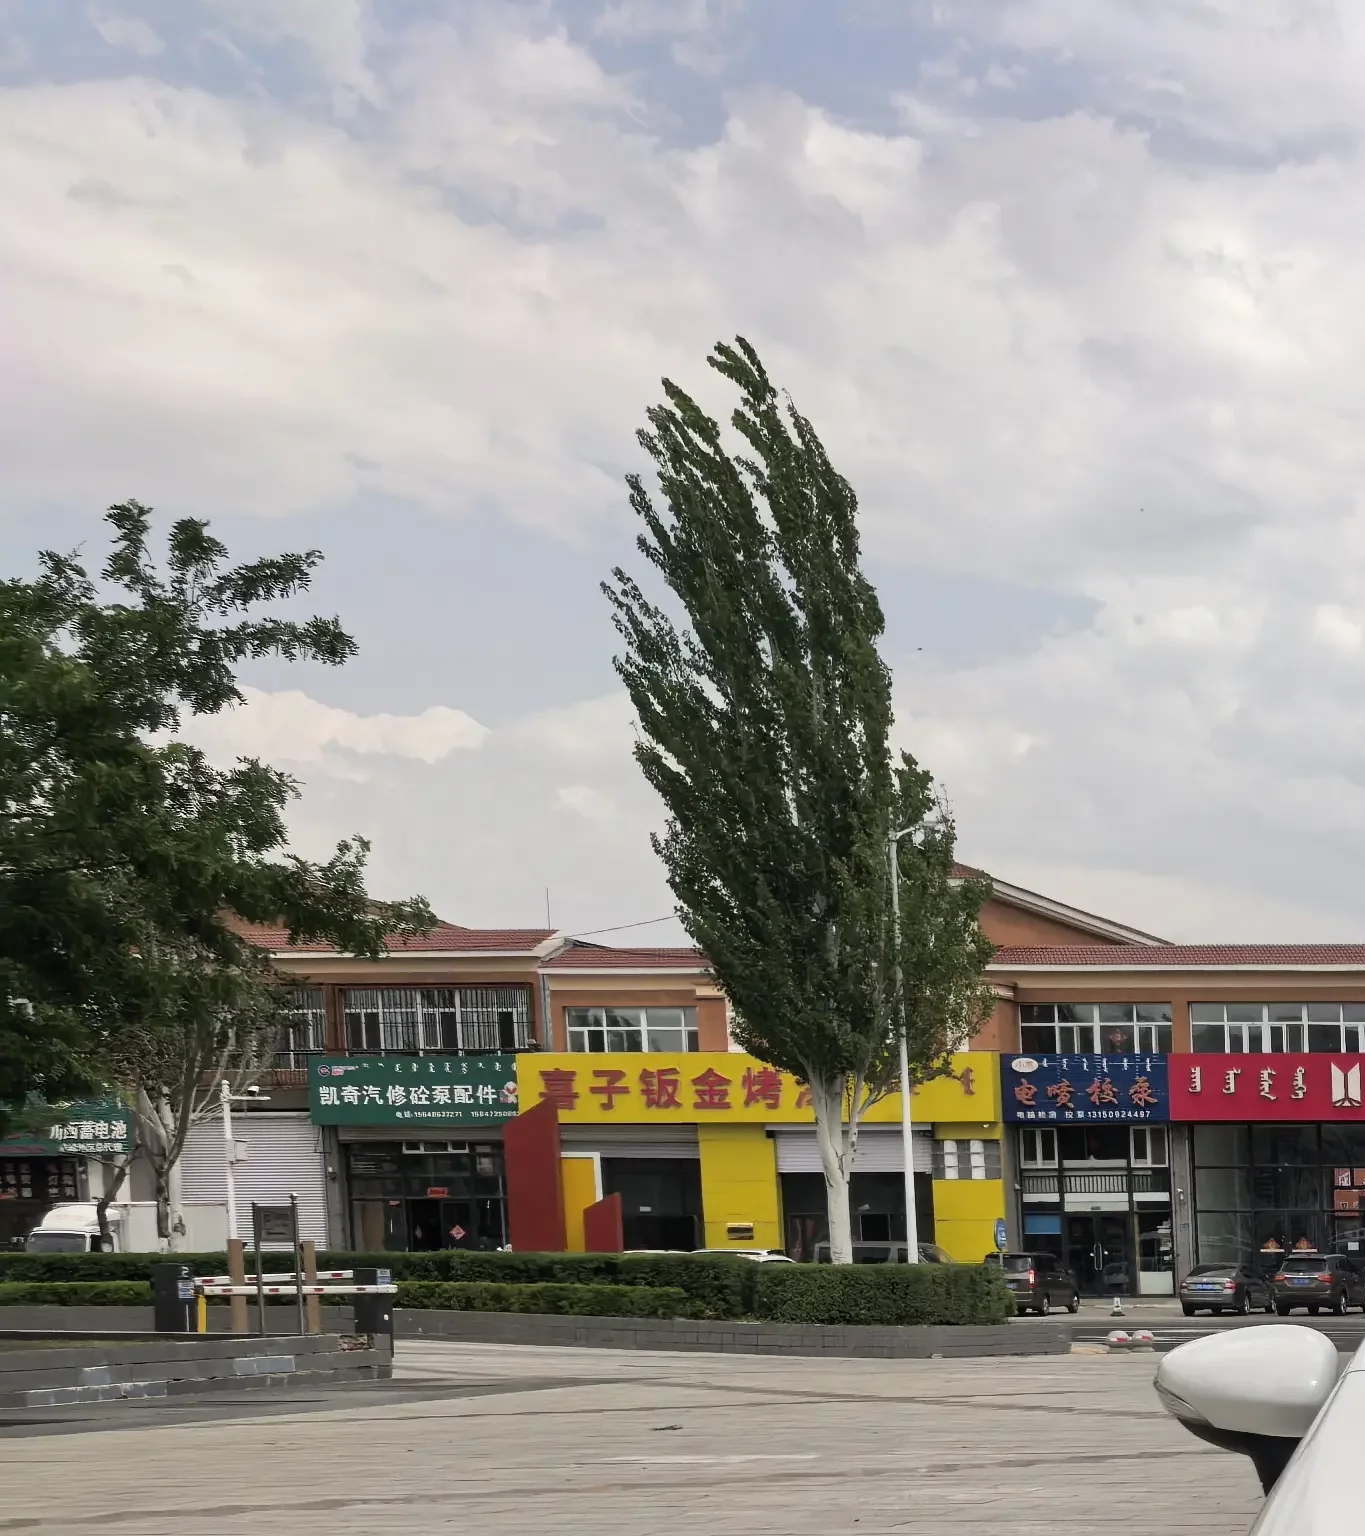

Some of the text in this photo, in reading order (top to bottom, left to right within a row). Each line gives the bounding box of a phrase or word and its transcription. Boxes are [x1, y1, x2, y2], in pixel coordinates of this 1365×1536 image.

[318, 1084, 498, 1107] 凯奇汽修砼泵配件
